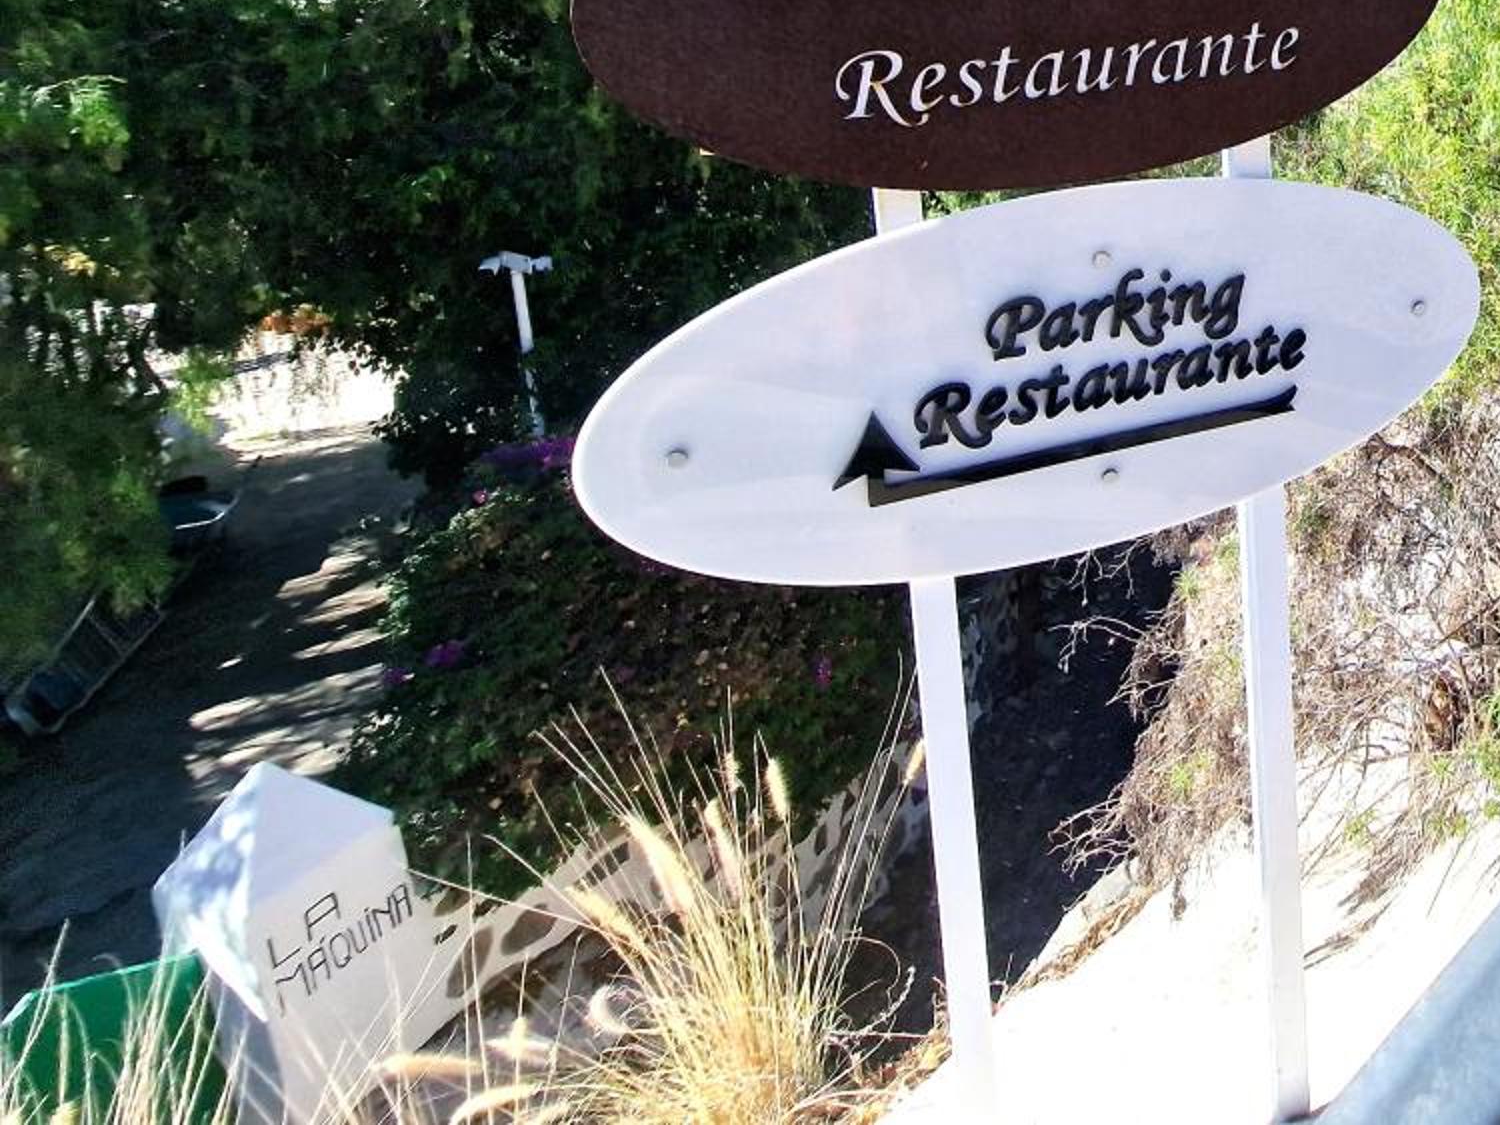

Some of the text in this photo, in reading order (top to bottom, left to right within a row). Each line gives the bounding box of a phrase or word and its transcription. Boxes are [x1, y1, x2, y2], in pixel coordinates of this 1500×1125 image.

[835, 22, 1299, 127] Restaurante
[984, 268, 1246, 363] Parking
[913, 324, 1307, 450] Restaurante
[266, 891, 341, 970] LA
